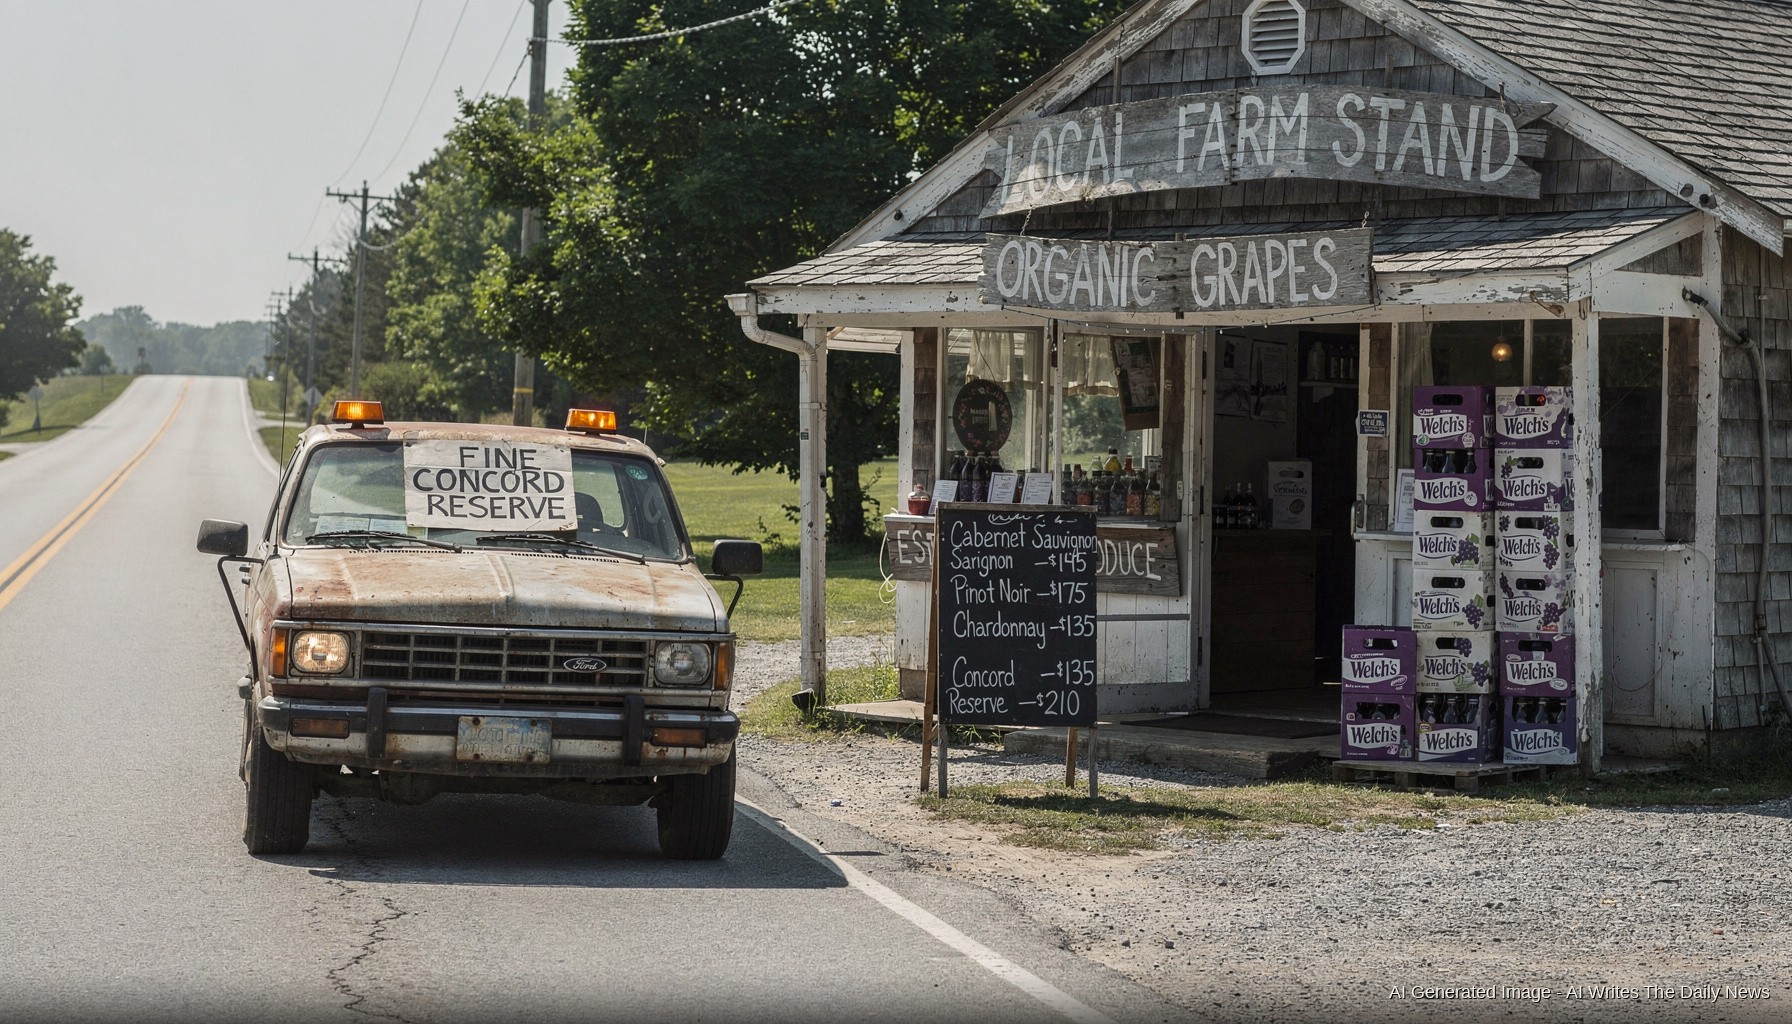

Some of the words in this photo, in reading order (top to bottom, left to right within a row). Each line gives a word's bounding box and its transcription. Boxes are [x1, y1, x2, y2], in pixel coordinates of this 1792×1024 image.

[999, 111, 1135, 205] LOCAL
[1175, 92, 1309, 173] FARM
[1333, 92, 1522, 182] STAND
[996, 239, 1156, 308] ORGANIC
[1190, 235, 1339, 308] GRAPES
[1420, 416, 1465, 435] Welch's
[1504, 416, 1549, 435] Welch's
[459, 446, 542, 470] FINE
[412, 468, 565, 493] CONCORD
[1421, 479, 1465, 498] Welch's
[1502, 479, 1546, 498] Welch's
[427, 494, 567, 520] RESERVE
[1418, 535, 1457, 554] Welch's
[1503, 537, 1541, 556] Welch's
[950, 547, 1013, 577] Sarignon
[950, 574, 995, 605] Pinot
[999, 578, 1032, 604] Noir
[1419, 597, 1460, 615] Welch's
[1505, 599, 1542, 617] Welch's
[953, 609, 1046, 649] Chardonnay
[572, 659, 598, 670] Ford
[952, 655, 1015, 688] Concord
[1351, 659, 1398, 679] Welch's
[1424, 657, 1467, 676] Welch's
[1510, 662, 1555, 681] Welch's
[946, 687, 1008, 715] Reserve
[1351, 727, 1398, 745] Welch's
[1426, 732, 1474, 751] Welch's
[1511, 732, 1560, 751] Welch's
